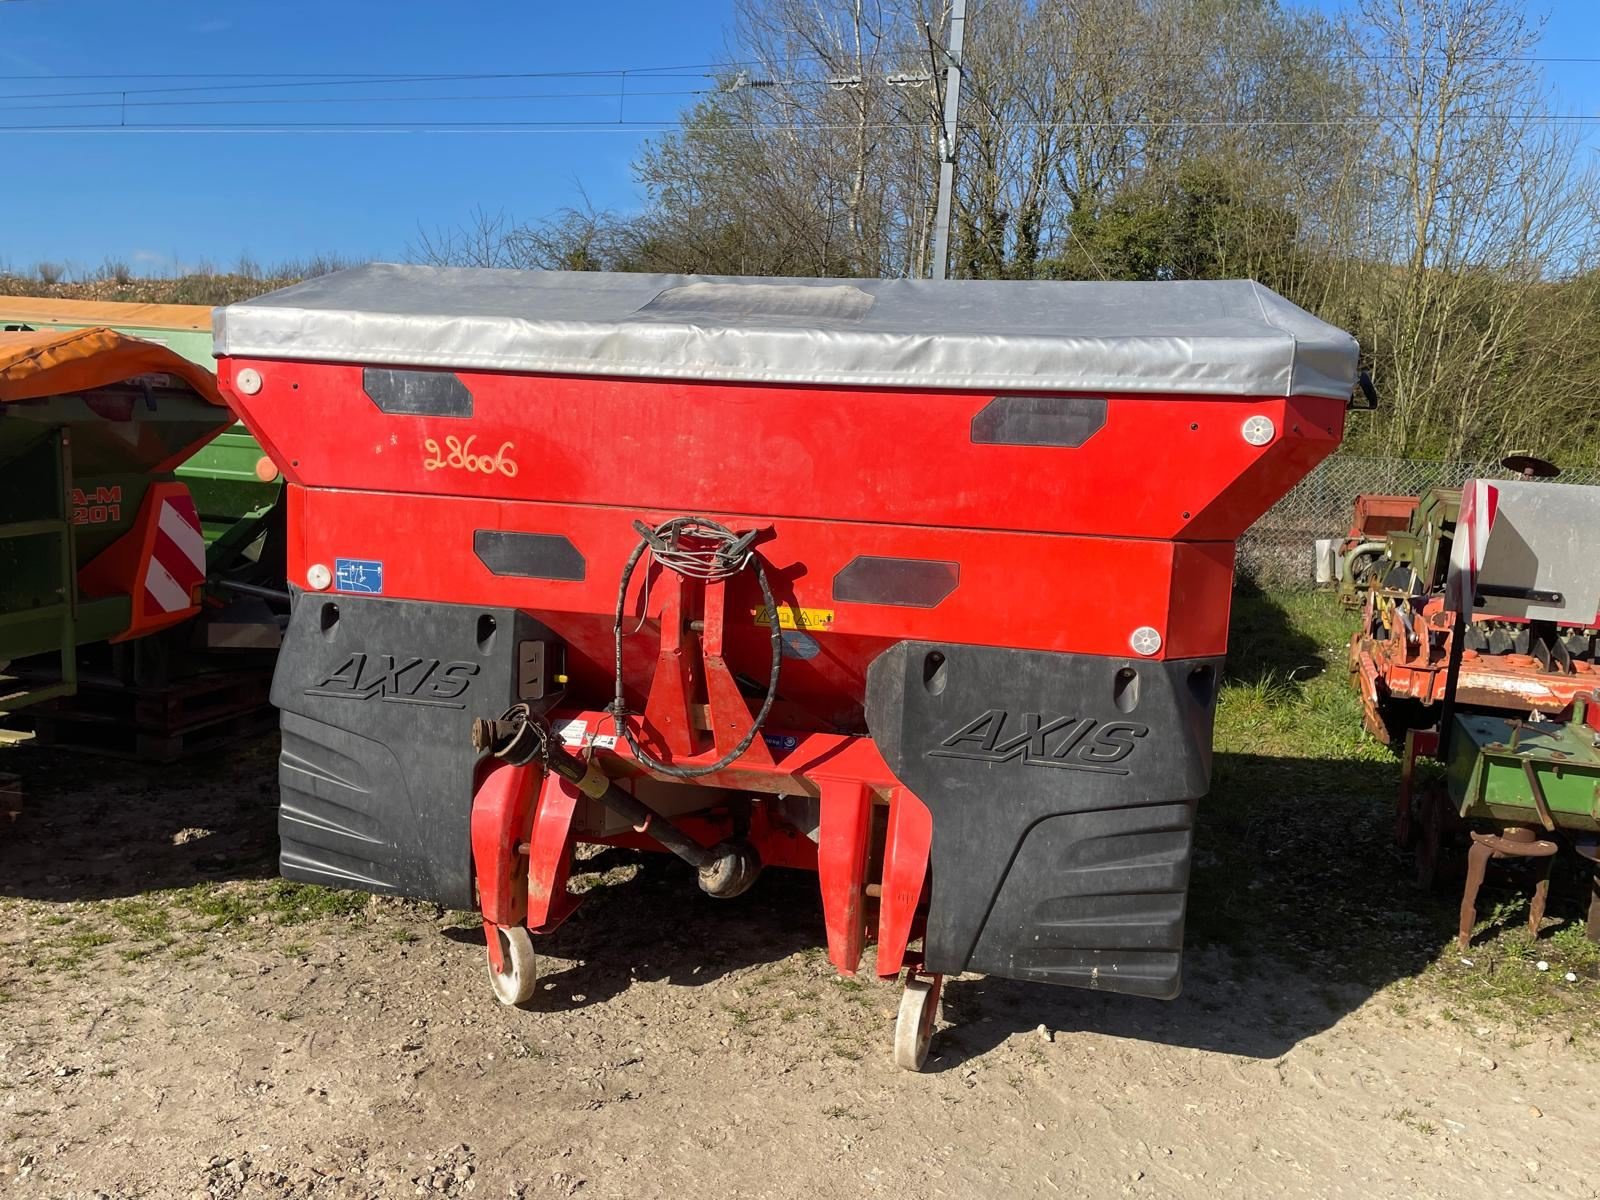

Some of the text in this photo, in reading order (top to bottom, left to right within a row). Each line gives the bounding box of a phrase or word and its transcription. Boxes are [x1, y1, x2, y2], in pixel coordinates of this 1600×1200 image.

[423, 435, 519, 478] 28606
[315, 652, 481, 698] AXIS
[940, 708, 1149, 763] AXIS
